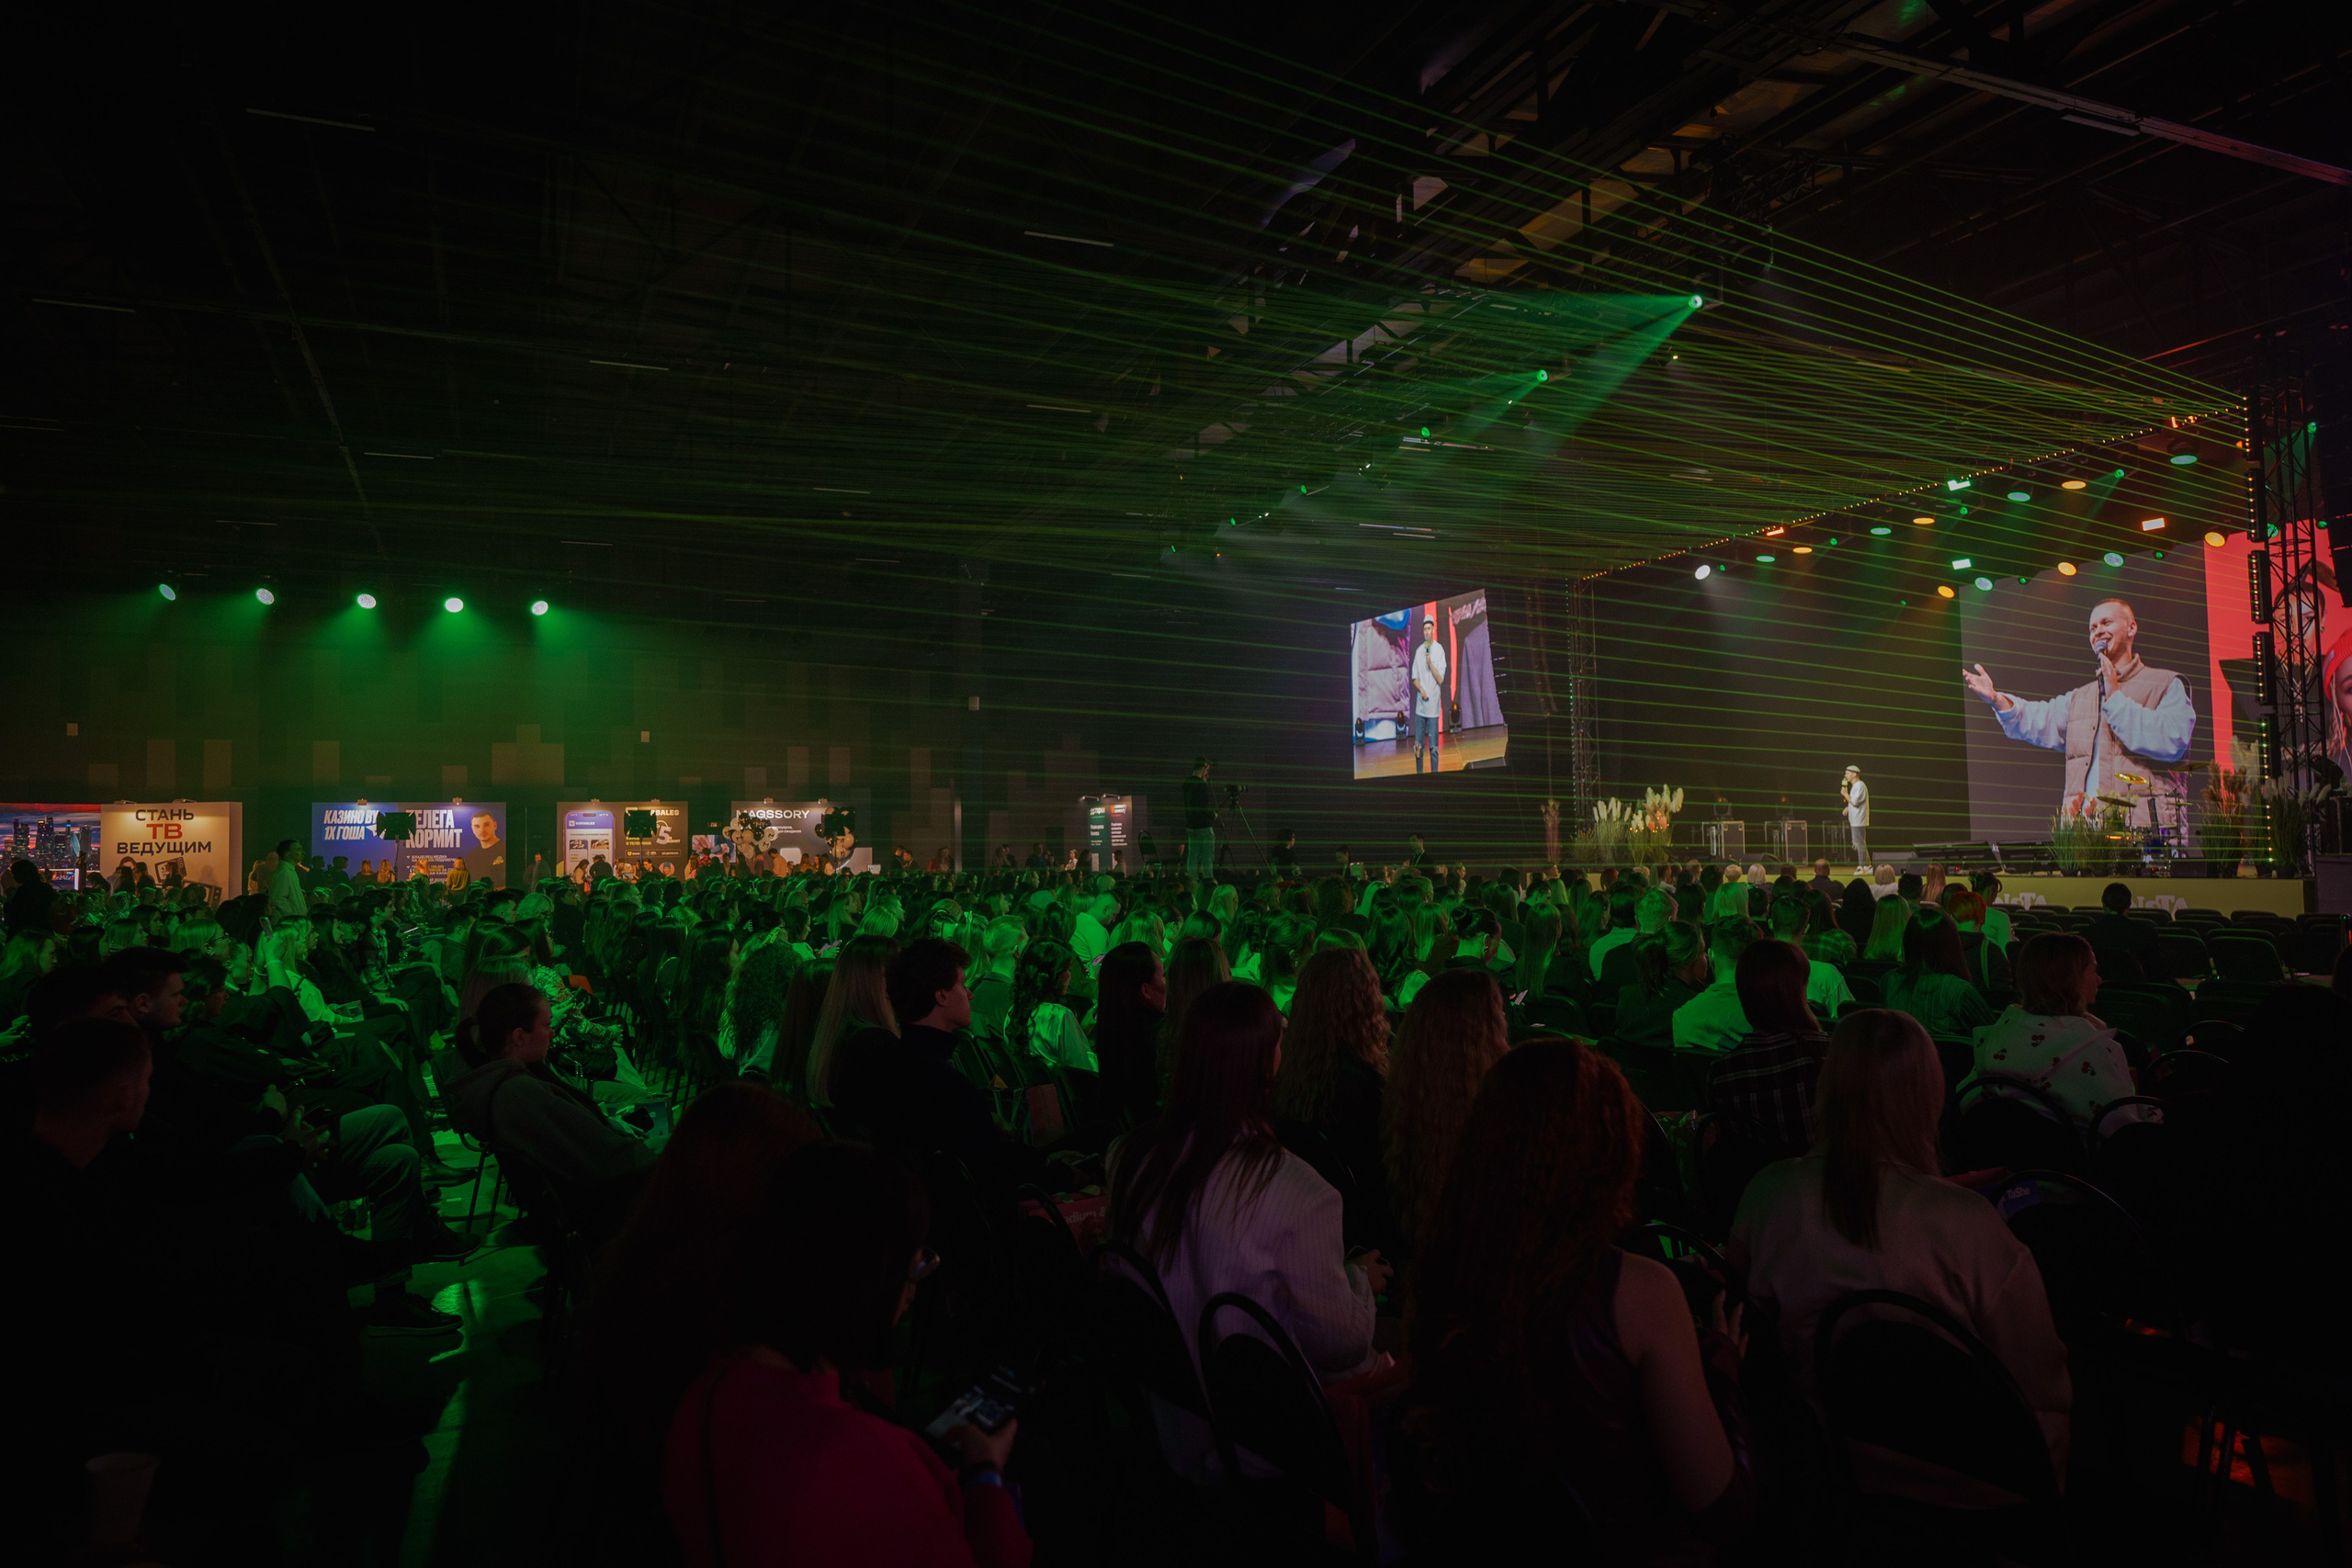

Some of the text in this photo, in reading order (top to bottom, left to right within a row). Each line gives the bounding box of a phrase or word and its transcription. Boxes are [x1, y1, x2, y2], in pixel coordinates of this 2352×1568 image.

[135, 808, 194, 821] СТАНЬ
[323, 809, 364, 824] КАЗИНО
[405, 809, 455, 829] ЕЛЕГА
[146, 823, 183, 840] ТВ
[337, 826, 365, 840] ГОША
[405, 829, 463, 848] КОРМИТ
[656, 825, 672, 845] 5
[117, 841, 211, 856] ВЕДУЩИМ
